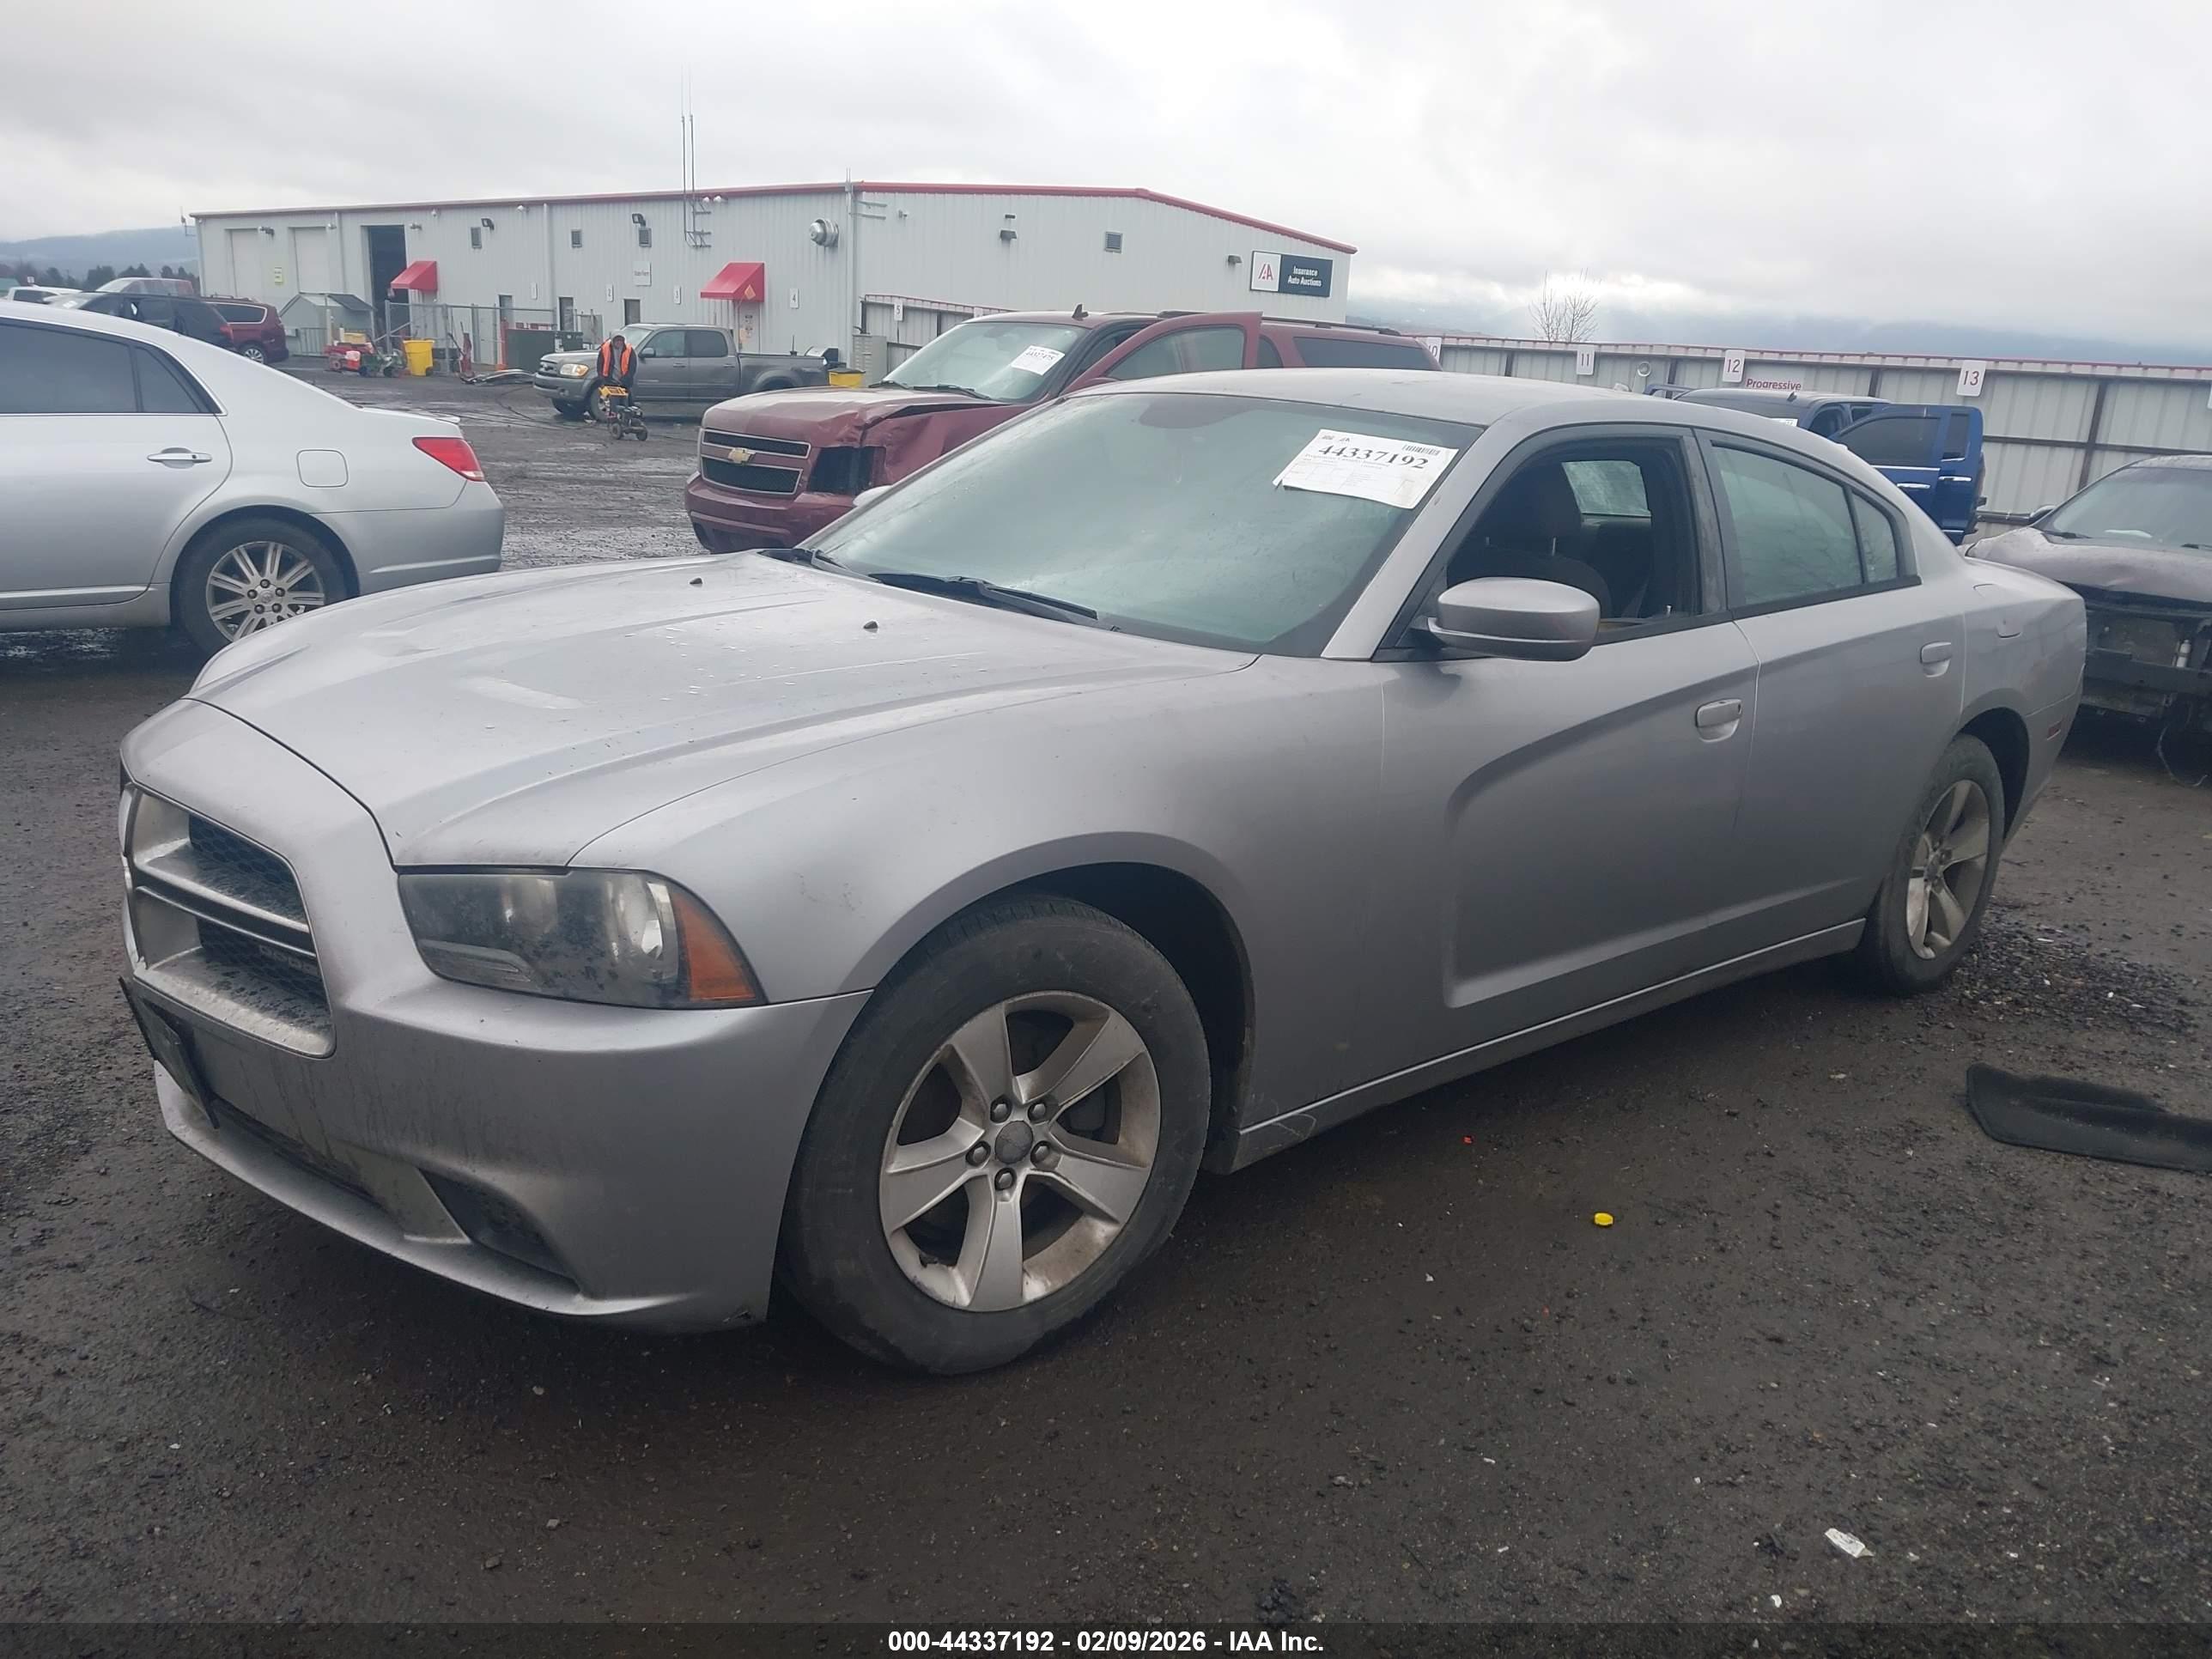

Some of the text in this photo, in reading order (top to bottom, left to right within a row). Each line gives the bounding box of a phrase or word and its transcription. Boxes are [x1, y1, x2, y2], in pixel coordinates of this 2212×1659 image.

[1293, 265, 1318, 276] Insurance
[1288, 275, 1322, 287] Auto Auctions
[792, 293, 796, 303] 4
[896, 305, 901, 315] 5
[1581, 353, 1589, 367] 11
[1727, 359, 1741, 373] 12
[1963, 370, 1979, 386] 13
[1746, 379, 1802, 391] Progressive
[1319, 445, 1429, 469] 44337192
